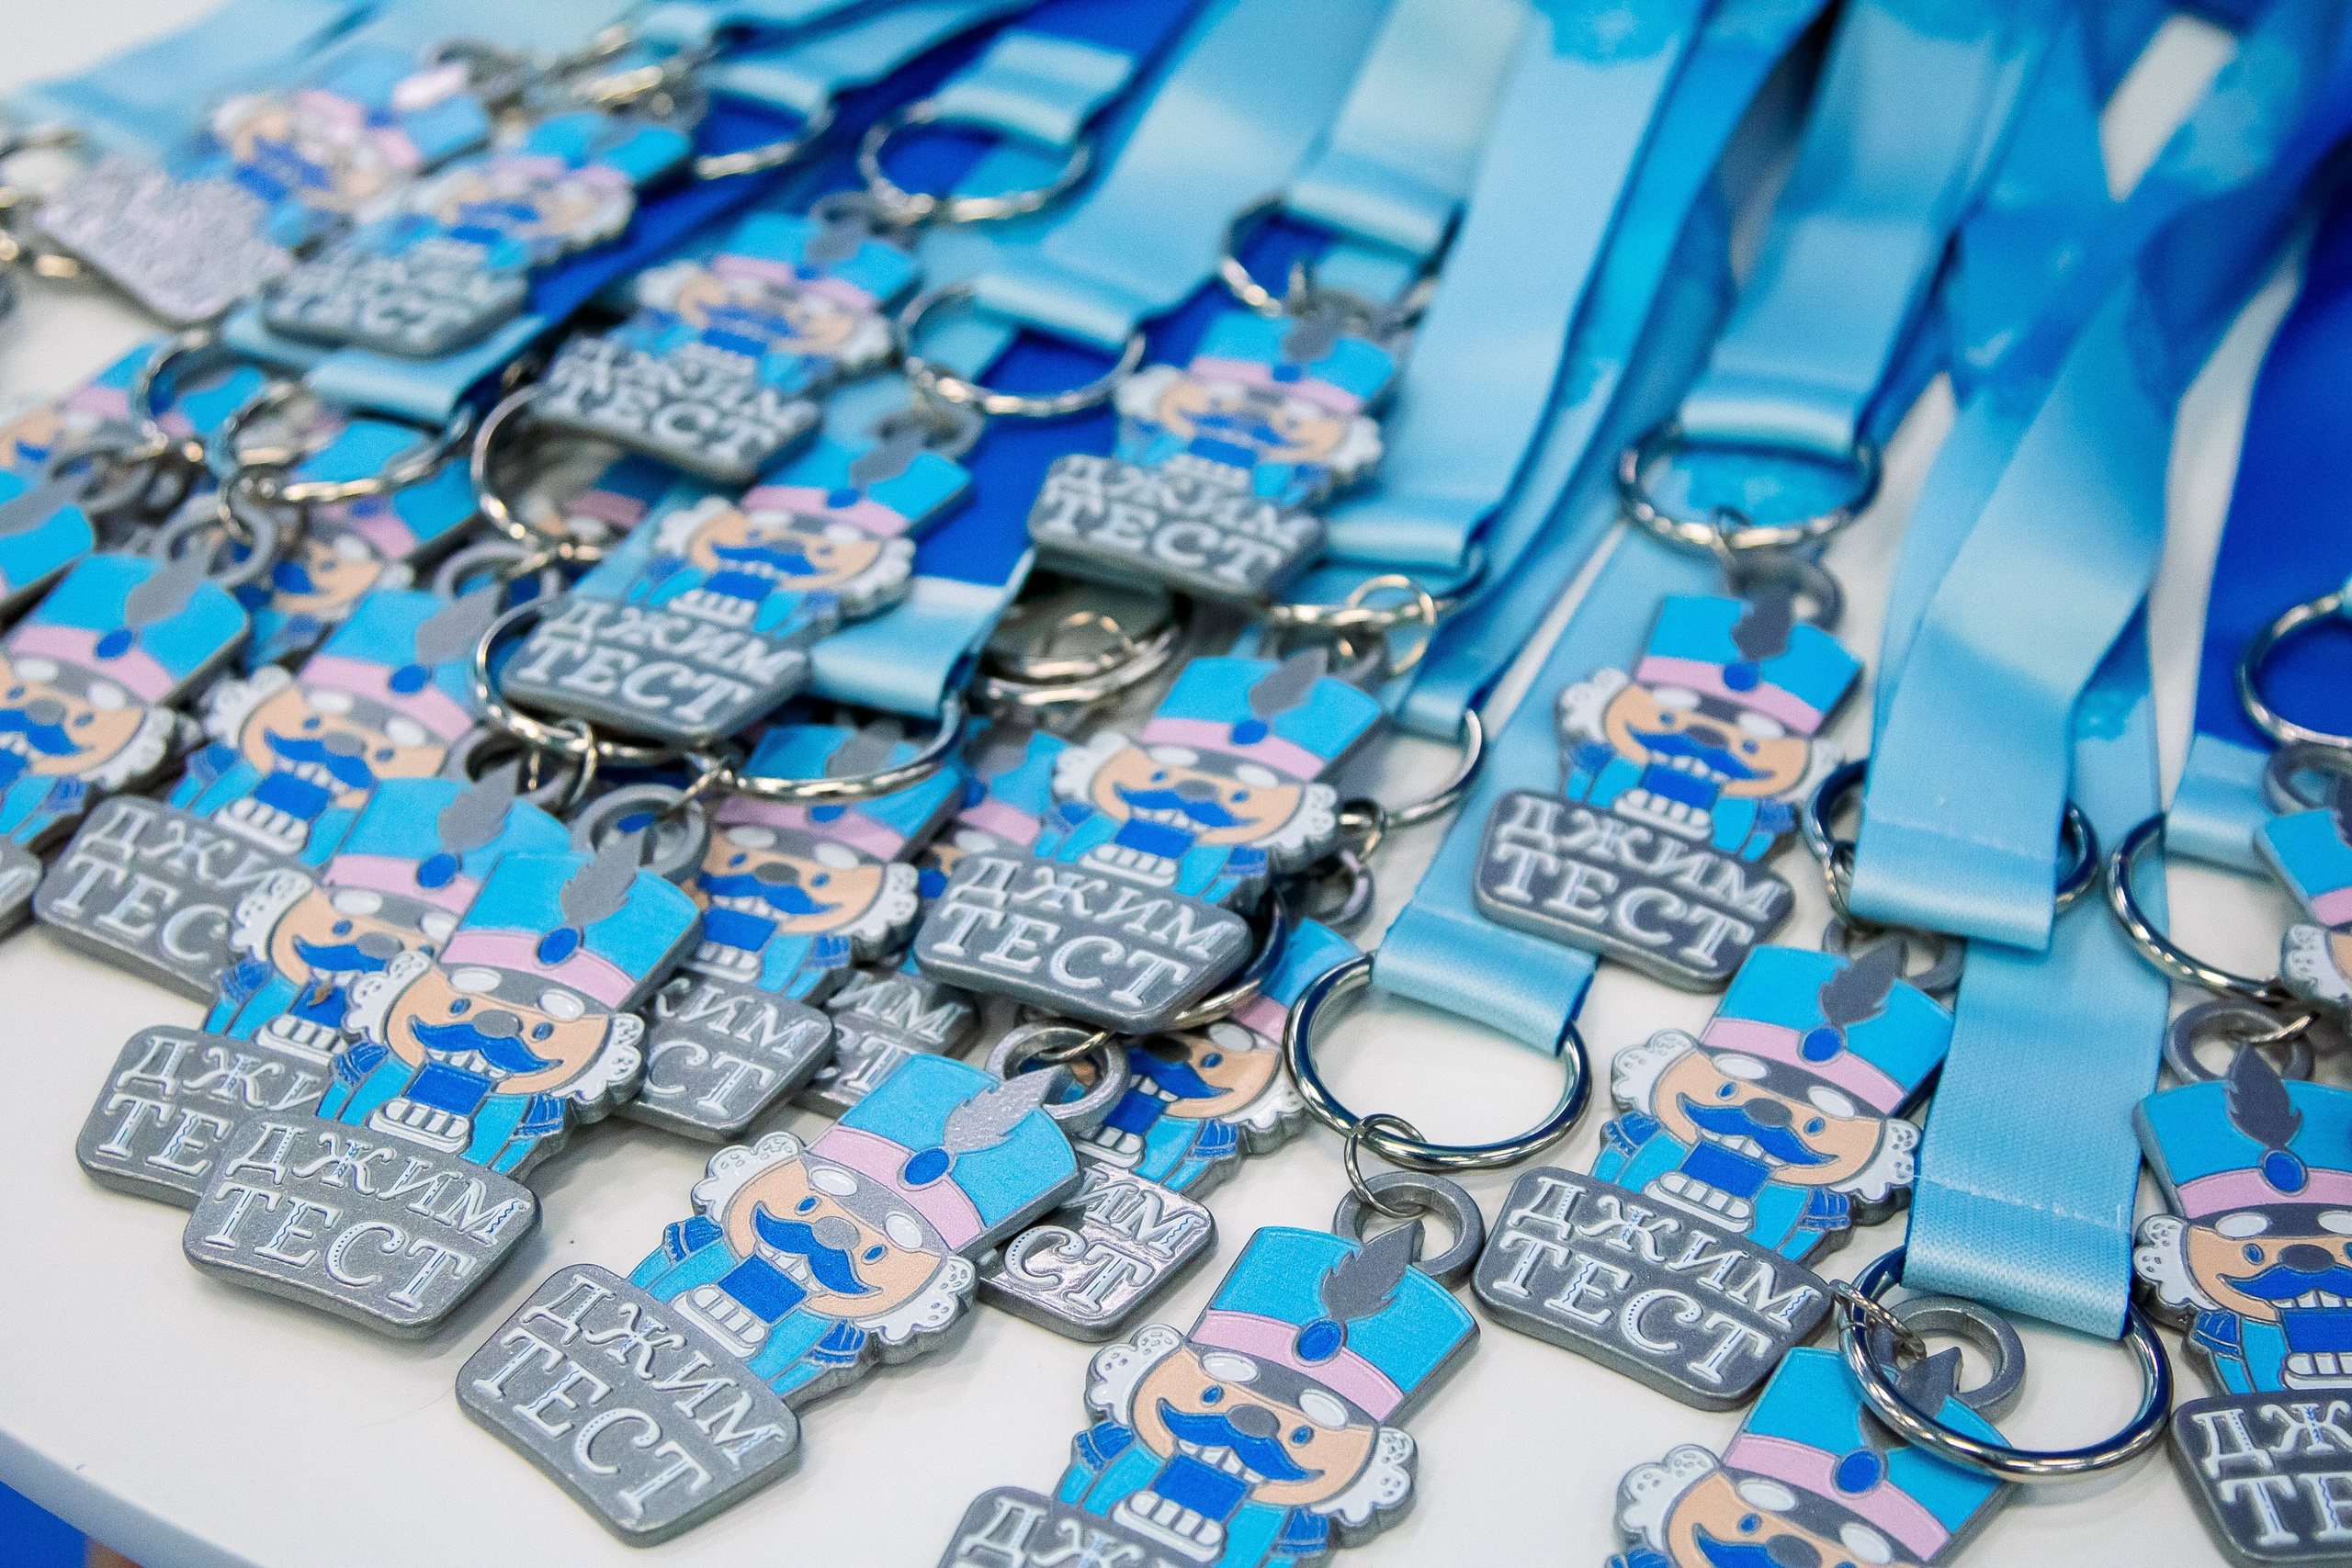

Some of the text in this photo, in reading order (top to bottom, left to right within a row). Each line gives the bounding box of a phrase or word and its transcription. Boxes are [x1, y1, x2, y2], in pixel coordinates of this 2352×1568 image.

[1040, 489, 1283, 582] ТЕСТ
[516, 636, 754, 722] ТЕСТ
[544, 602, 806, 685] ДЖИМ
[76, 804, 272, 888] ДЖИ
[1496, 795, 1786, 921] ДЖИМ
[51, 854, 231, 962] ТЕС
[932, 901, 1192, 1007] ТЕСТ
[947, 857, 1242, 960] ДЖИМ
[1492, 842, 1755, 968] ТЕСТ
[645, 1040, 776, 1117] СТ
[96, 1092, 233, 1178] ТЕ
[224, 1122, 532, 1246] ДЖИМ
[204, 1181, 478, 1312] ТЕСТ
[1004, 1224, 1155, 1313] СТ
[1507, 1176, 1824, 1333] ДЖИМ
[1493, 1229, 1773, 1383] ТЕСТ
[472, 1326, 714, 1517] ТЕСТ
[519, 1273, 786, 1471] ДЖИМ
[2190, 1400, 2352, 1480] ДЖ
[2218, 1472, 2352, 1547] ТЕ
